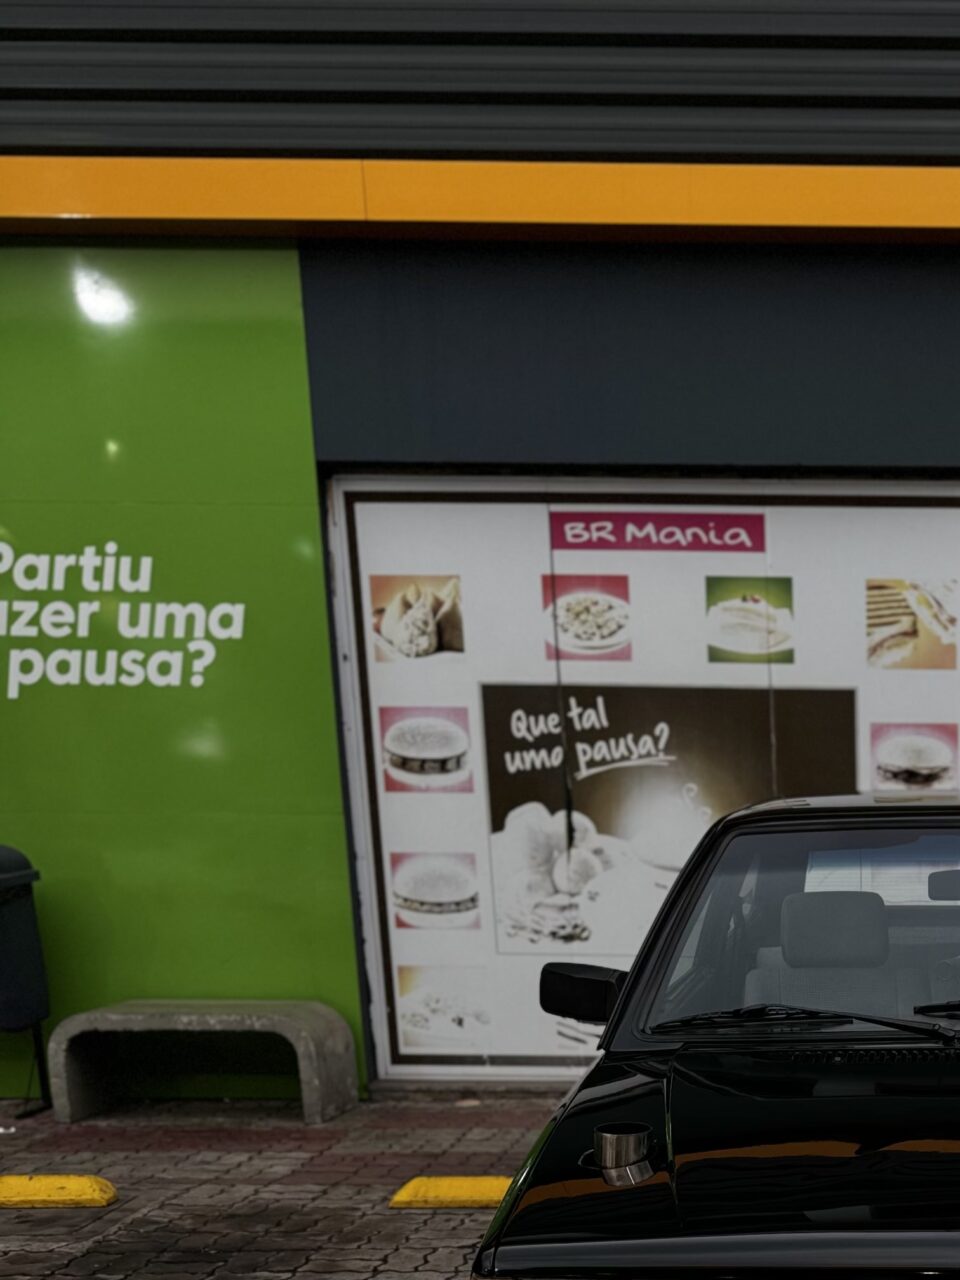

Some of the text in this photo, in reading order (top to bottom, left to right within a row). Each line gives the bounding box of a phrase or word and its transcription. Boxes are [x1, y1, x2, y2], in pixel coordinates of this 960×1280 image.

[563, 521, 753, 548] BR Mania
[0, 600, 246, 640] zer uma
[7, 640, 217, 699] pausa?
[510, 695, 609, 743] Que tal
[573, 721, 671, 777] pausa?
